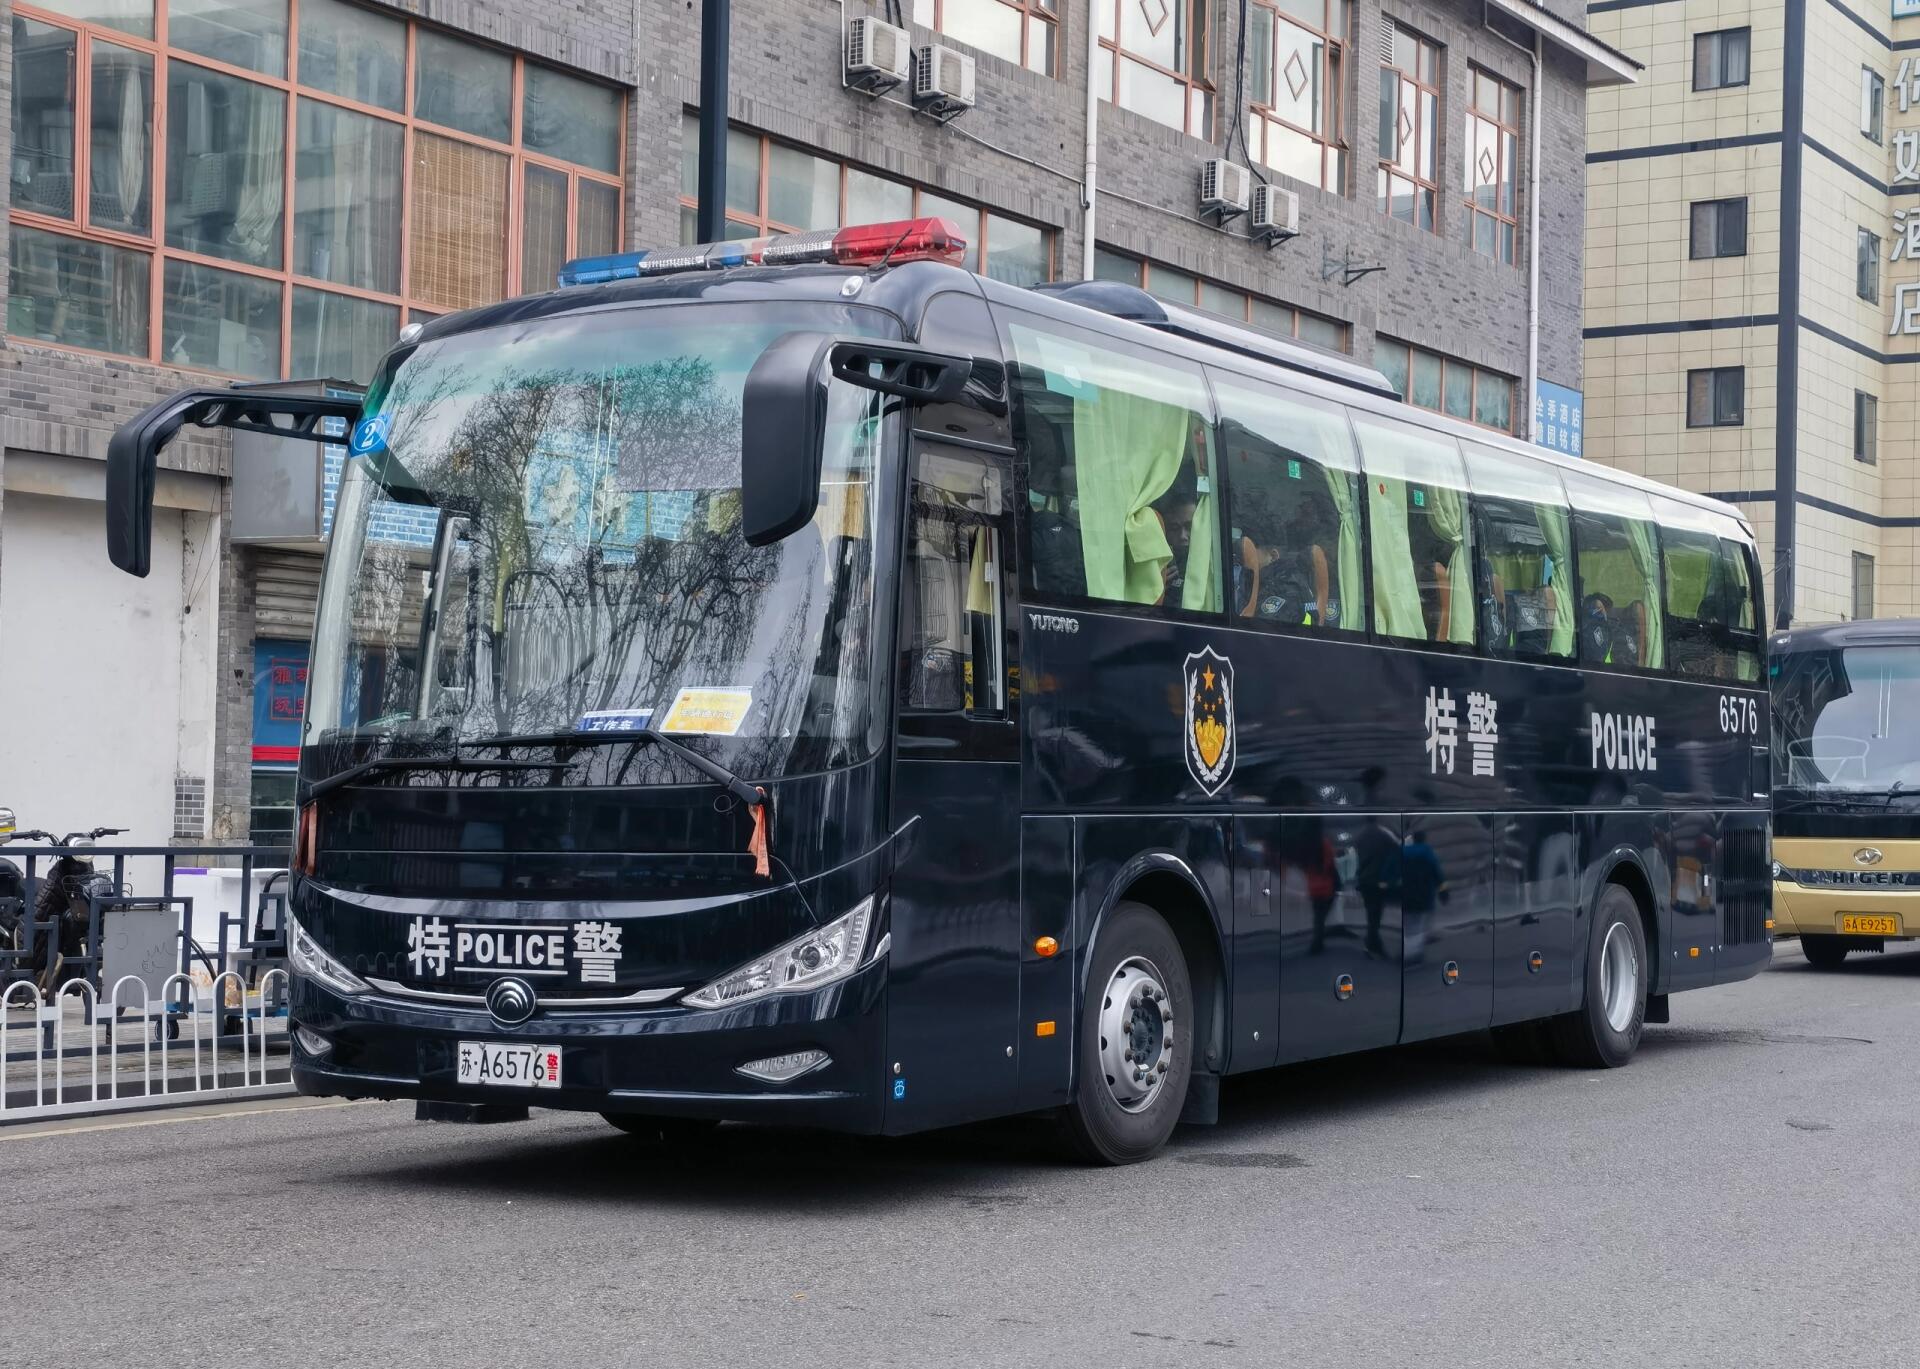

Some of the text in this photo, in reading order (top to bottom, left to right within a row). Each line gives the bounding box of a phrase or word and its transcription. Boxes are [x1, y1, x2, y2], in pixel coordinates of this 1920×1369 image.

[361, 422, 377, 448] 2
[1028, 613, 1080, 634] YUTONG
[1720, 694, 1758, 735] 6576
[1424, 686, 1657, 777] 特警 POLICE
[1832, 871, 1905, 884] HIGER
[408, 916, 623, 983] 特 POLICE 警
